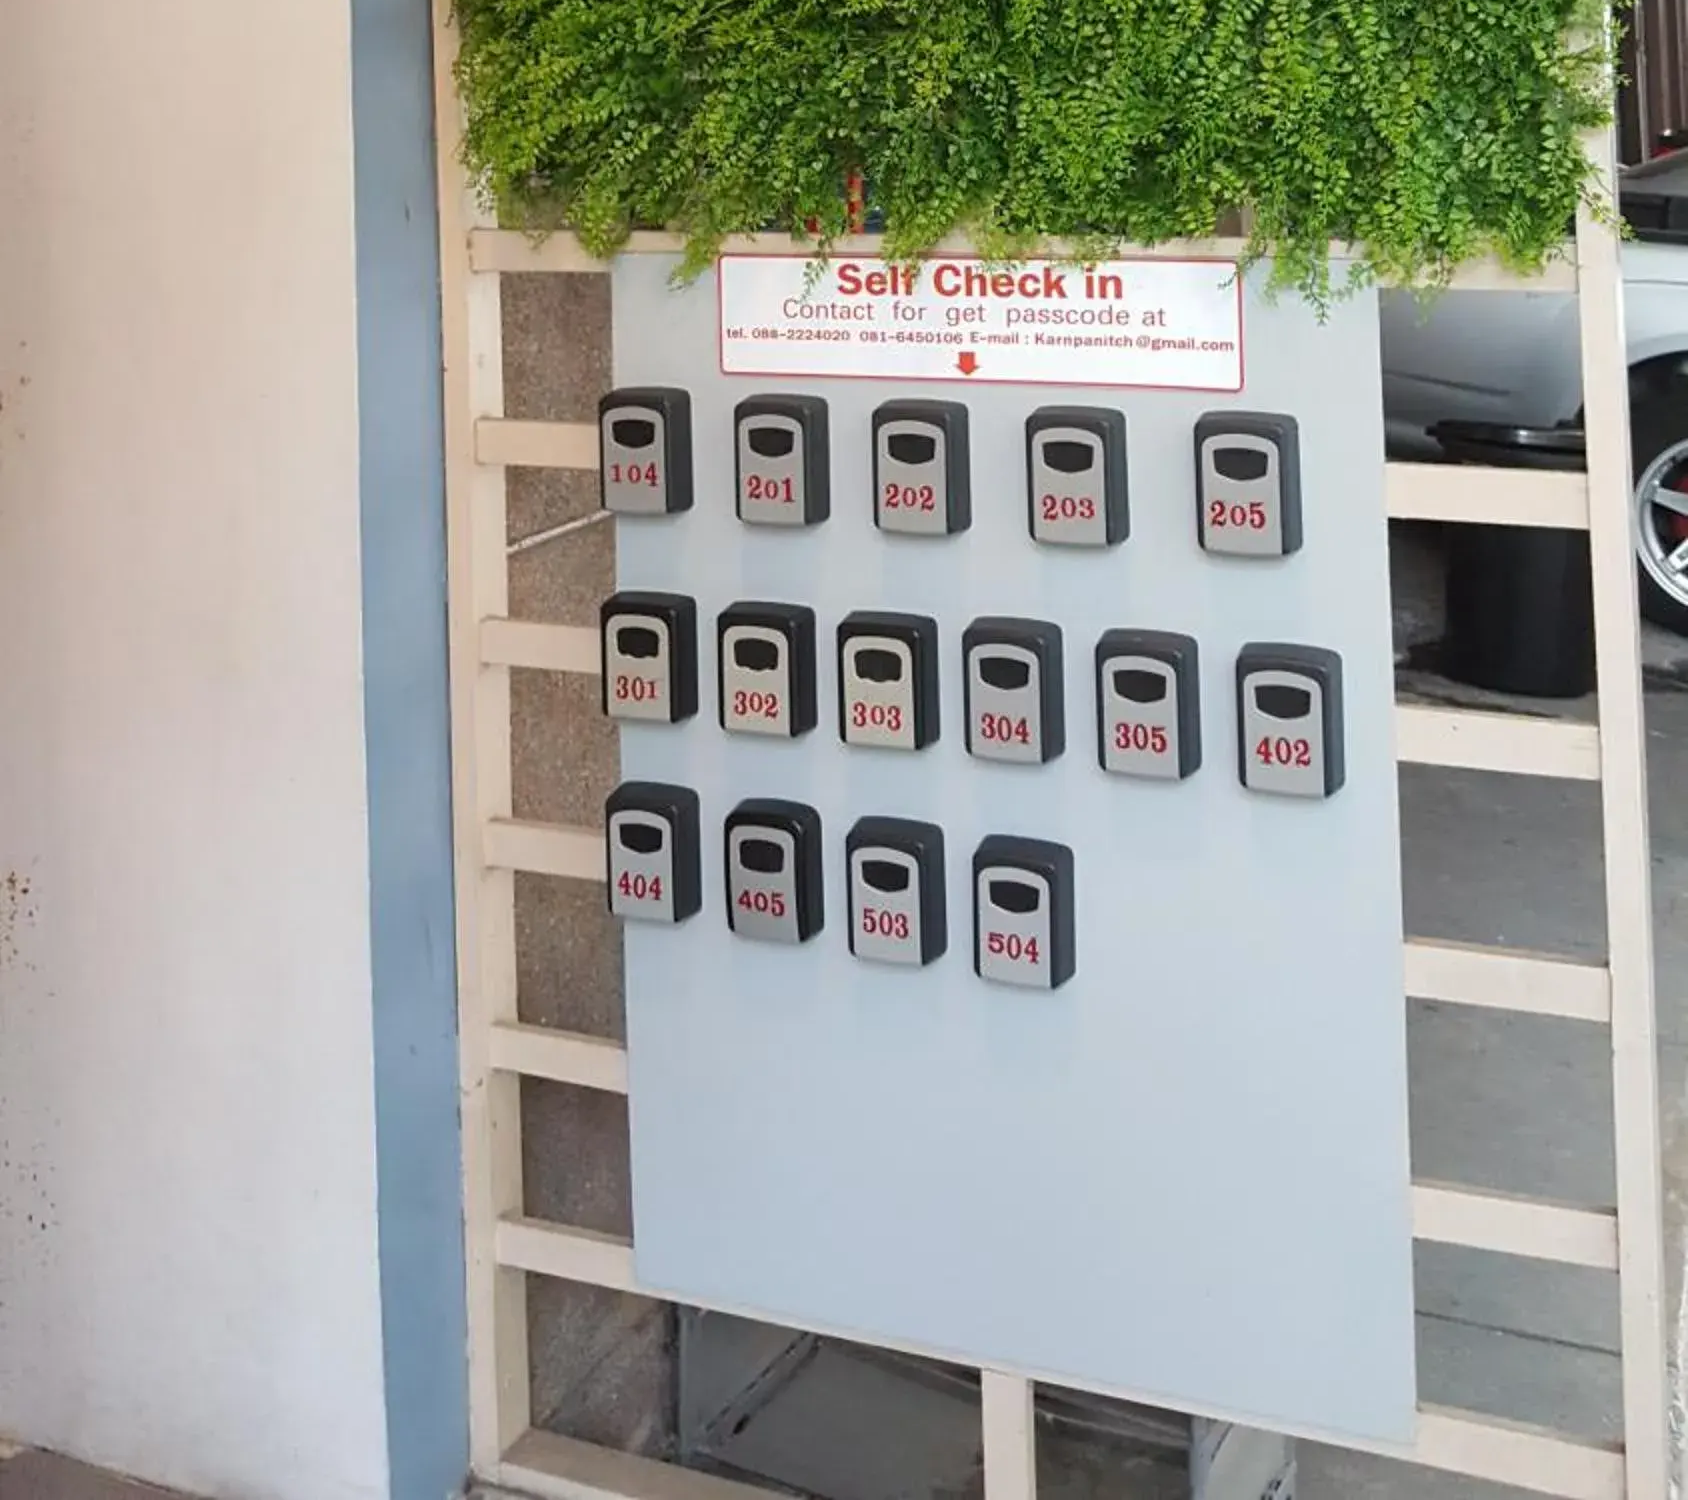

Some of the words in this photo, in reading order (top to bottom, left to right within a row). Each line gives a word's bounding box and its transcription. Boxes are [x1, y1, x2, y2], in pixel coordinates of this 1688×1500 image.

[836, 262, 914, 297] Self
[932, 265, 1068, 299] Check
[1083, 265, 1124, 300] in
[782, 300, 874, 322] Contact
[893, 301, 926, 322] for
[945, 303, 987, 326] get
[1005, 305, 1131, 330] passcode
[1141, 308, 1167, 327] at
[726, 327, 748, 340] tel.
[969, 331, 1020, 346] E-mail
[609, 462, 660, 488] 104
[743, 473, 795, 505] 201
[882, 482, 937, 517] 202
[1041, 493, 1096, 522] 203
[1209, 500, 1267, 530] 205
[615, 675, 659, 702] 301
[733, 690, 780, 719] 302
[852, 701, 903, 732] 303
[981, 713, 1032, 743] 304
[1114, 721, 1169, 756] 305
[1254, 737, 1311, 769] 402
[617, 871, 663, 901] 404
[736, 891, 787, 916] 405
[863, 908, 909, 939] 503
[987, 932, 1040, 964] 504
